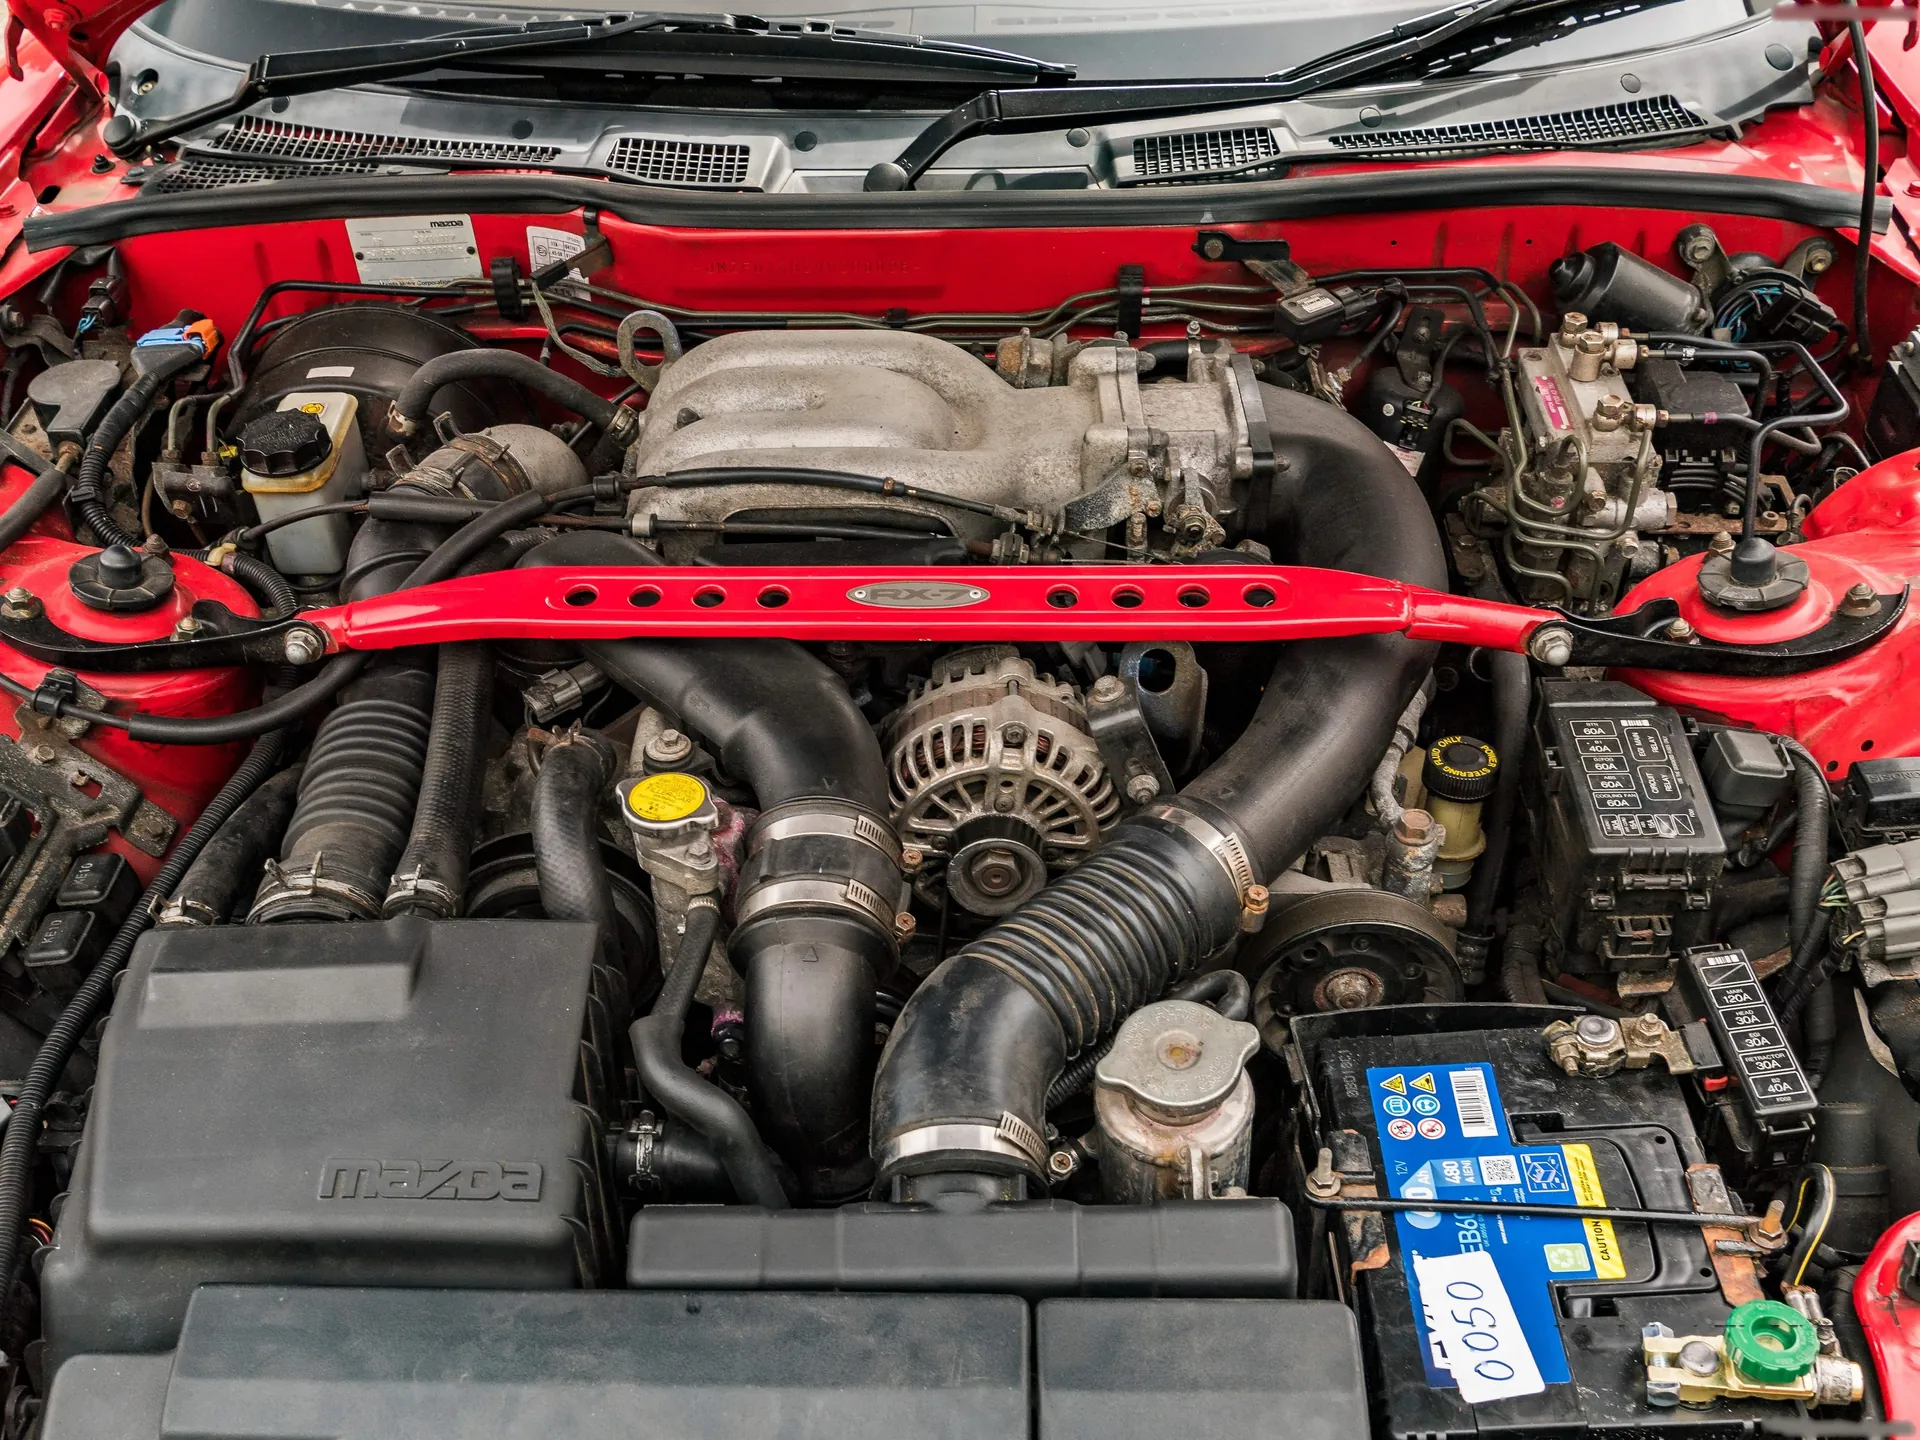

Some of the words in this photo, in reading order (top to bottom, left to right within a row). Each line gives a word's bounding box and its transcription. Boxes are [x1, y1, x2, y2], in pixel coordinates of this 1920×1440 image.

[430, 220, 463, 228] mazda
[870, 588, 970, 601] RX-7
[1437, 735, 1462, 748] ONLY
[1647, 735, 1659, 753] RELAY
[1589, 745, 1611, 753] 40A
[1431, 747, 1444, 766] FLUID
[1480, 744, 1498, 768] POWER
[1442, 765, 1491, 777] STEERING
[1606, 799, 1630, 807] 60A
[1723, 993, 1753, 1003] 120A
[1735, 1015, 1761, 1025] 30A
[1745, 1037, 1771, 1047] 30A
[1745, 1053, 1786, 1062] RETRACTOR
[1755, 1059, 1782, 1070] 30A
[1767, 1082, 1793, 1093] 40A
[1394, 1160, 1408, 1176] 12V
[1442, 1160, 1462, 1184] 480
[318, 1158, 544, 1201] mazda
[1591, 1220, 1611, 1261] CAUTION
[1446, 1281, 1515, 1381] 0050
